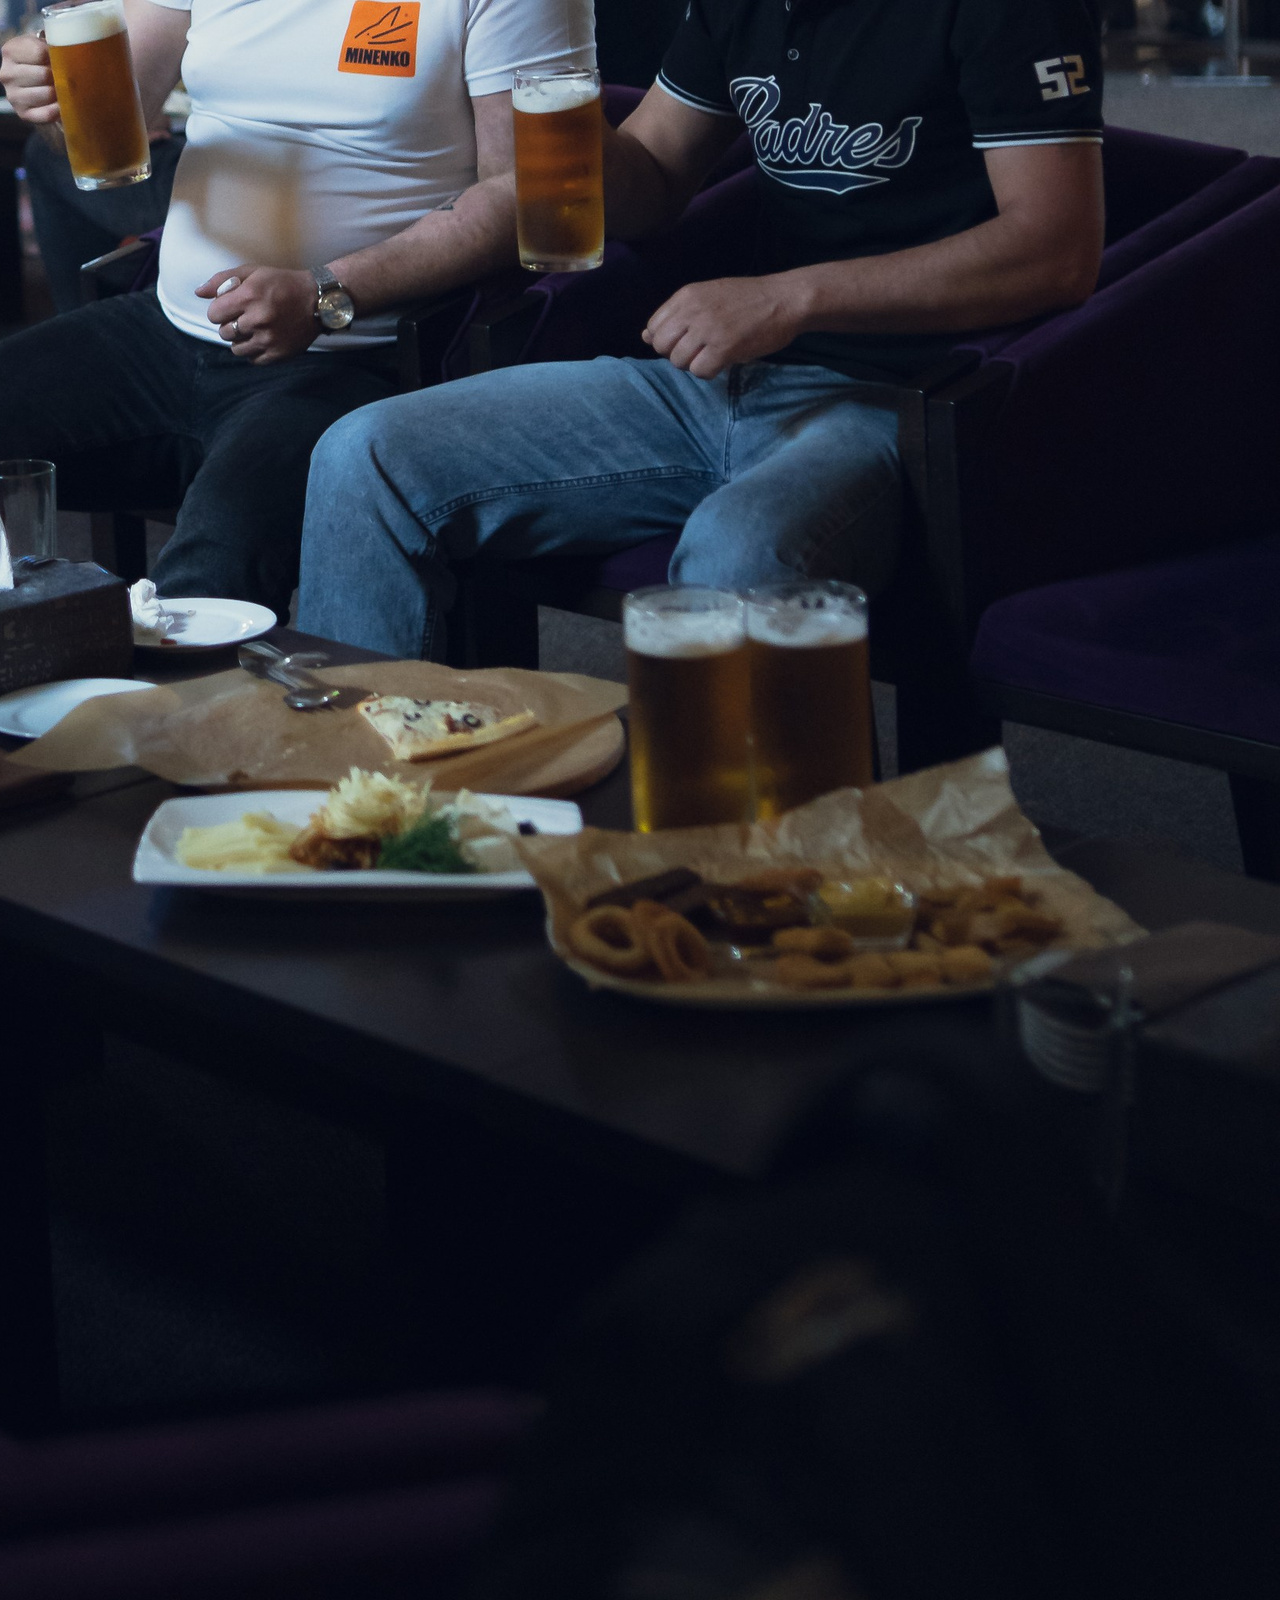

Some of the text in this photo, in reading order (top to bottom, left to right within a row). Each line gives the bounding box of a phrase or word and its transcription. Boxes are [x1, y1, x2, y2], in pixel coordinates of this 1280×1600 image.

[345, 48, 410, 67] MINENKO
[1033, 55, 1091, 101] 52
[729, 75, 923, 169] Padres
